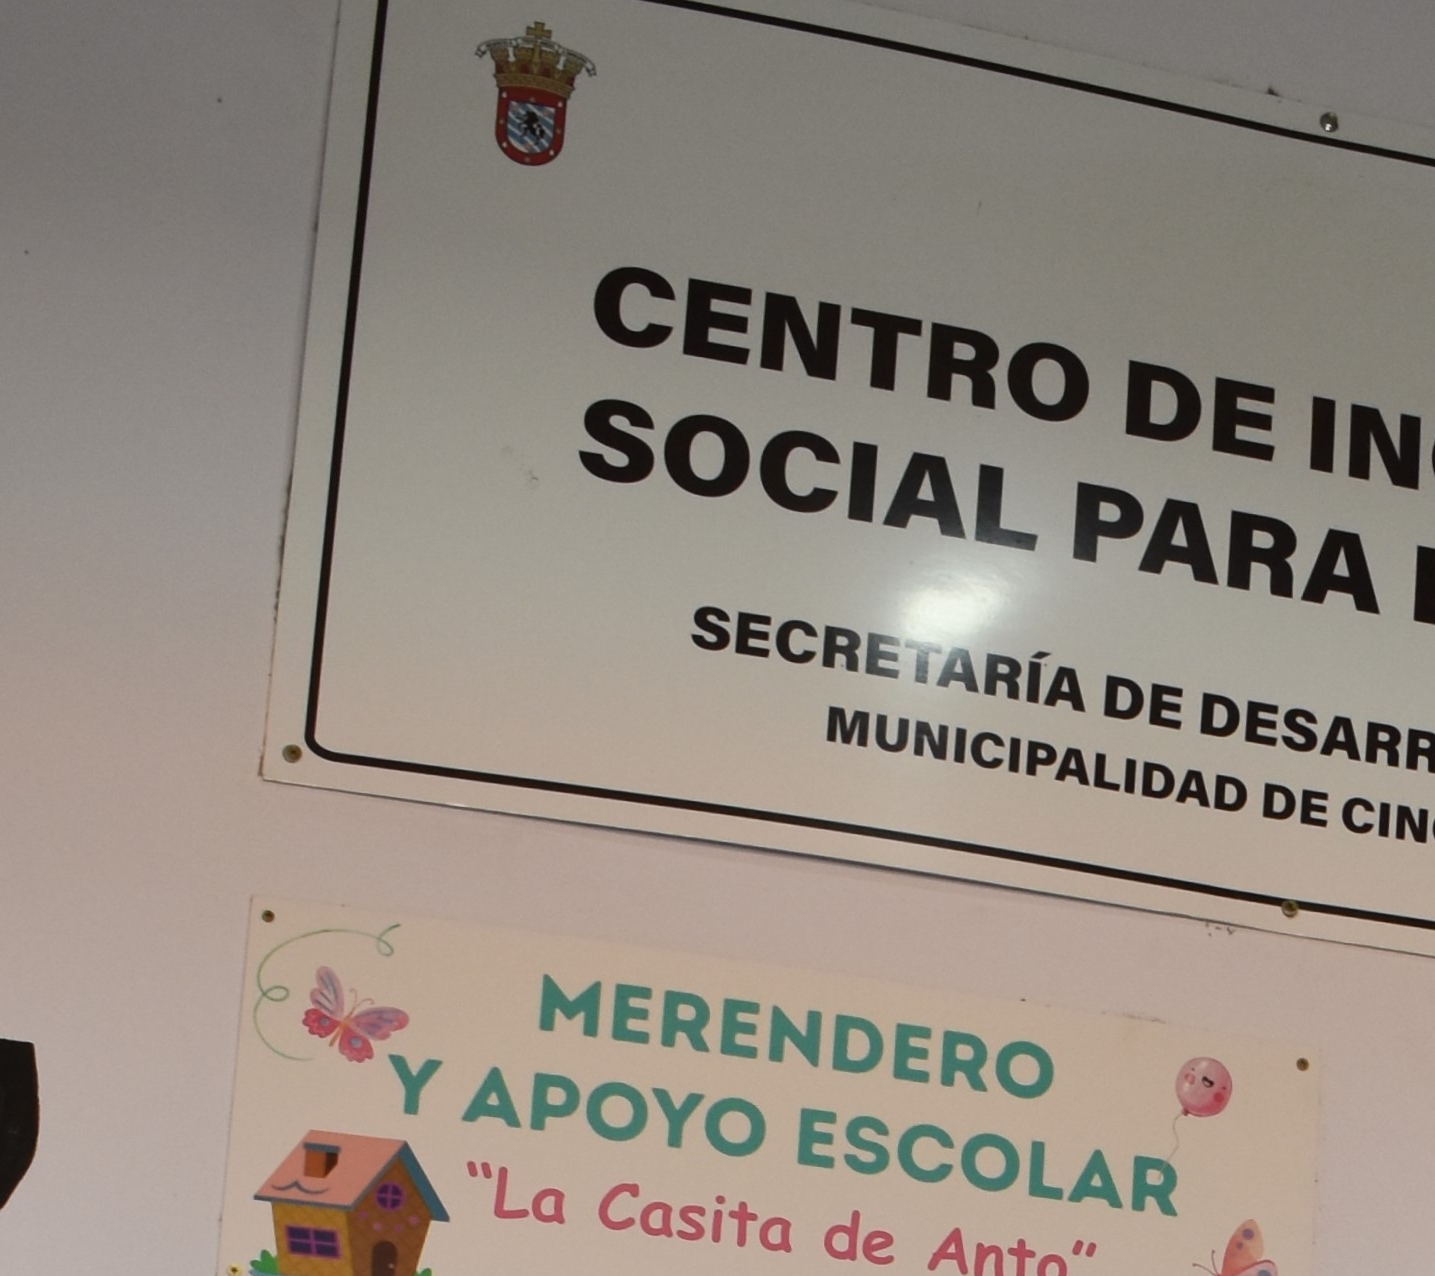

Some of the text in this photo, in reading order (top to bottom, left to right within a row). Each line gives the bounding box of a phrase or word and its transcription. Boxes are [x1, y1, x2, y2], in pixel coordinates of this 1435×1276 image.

[593, 265, 1090, 423] CENTRO
[1124, 359, 1276, 462] DE
[578, 398, 1039, 552] SOCIAL
[1072, 480, 1380, 616] PARA
[691, 605, 1086, 713] SECRETARÍA
[1104, 674, 1184, 730] DE
[826, 705, 1249, 813] MUNICIPALIDAD
[1262, 783, 1330, 828] DE
[539, 972, 1055, 1100] MERENDERO
[388, 1054, 1180, 1216] Y APOYO ESCOLAR
[597, 1183, 793, 1254] Casita
[823, 1209, 895, 1266] de
